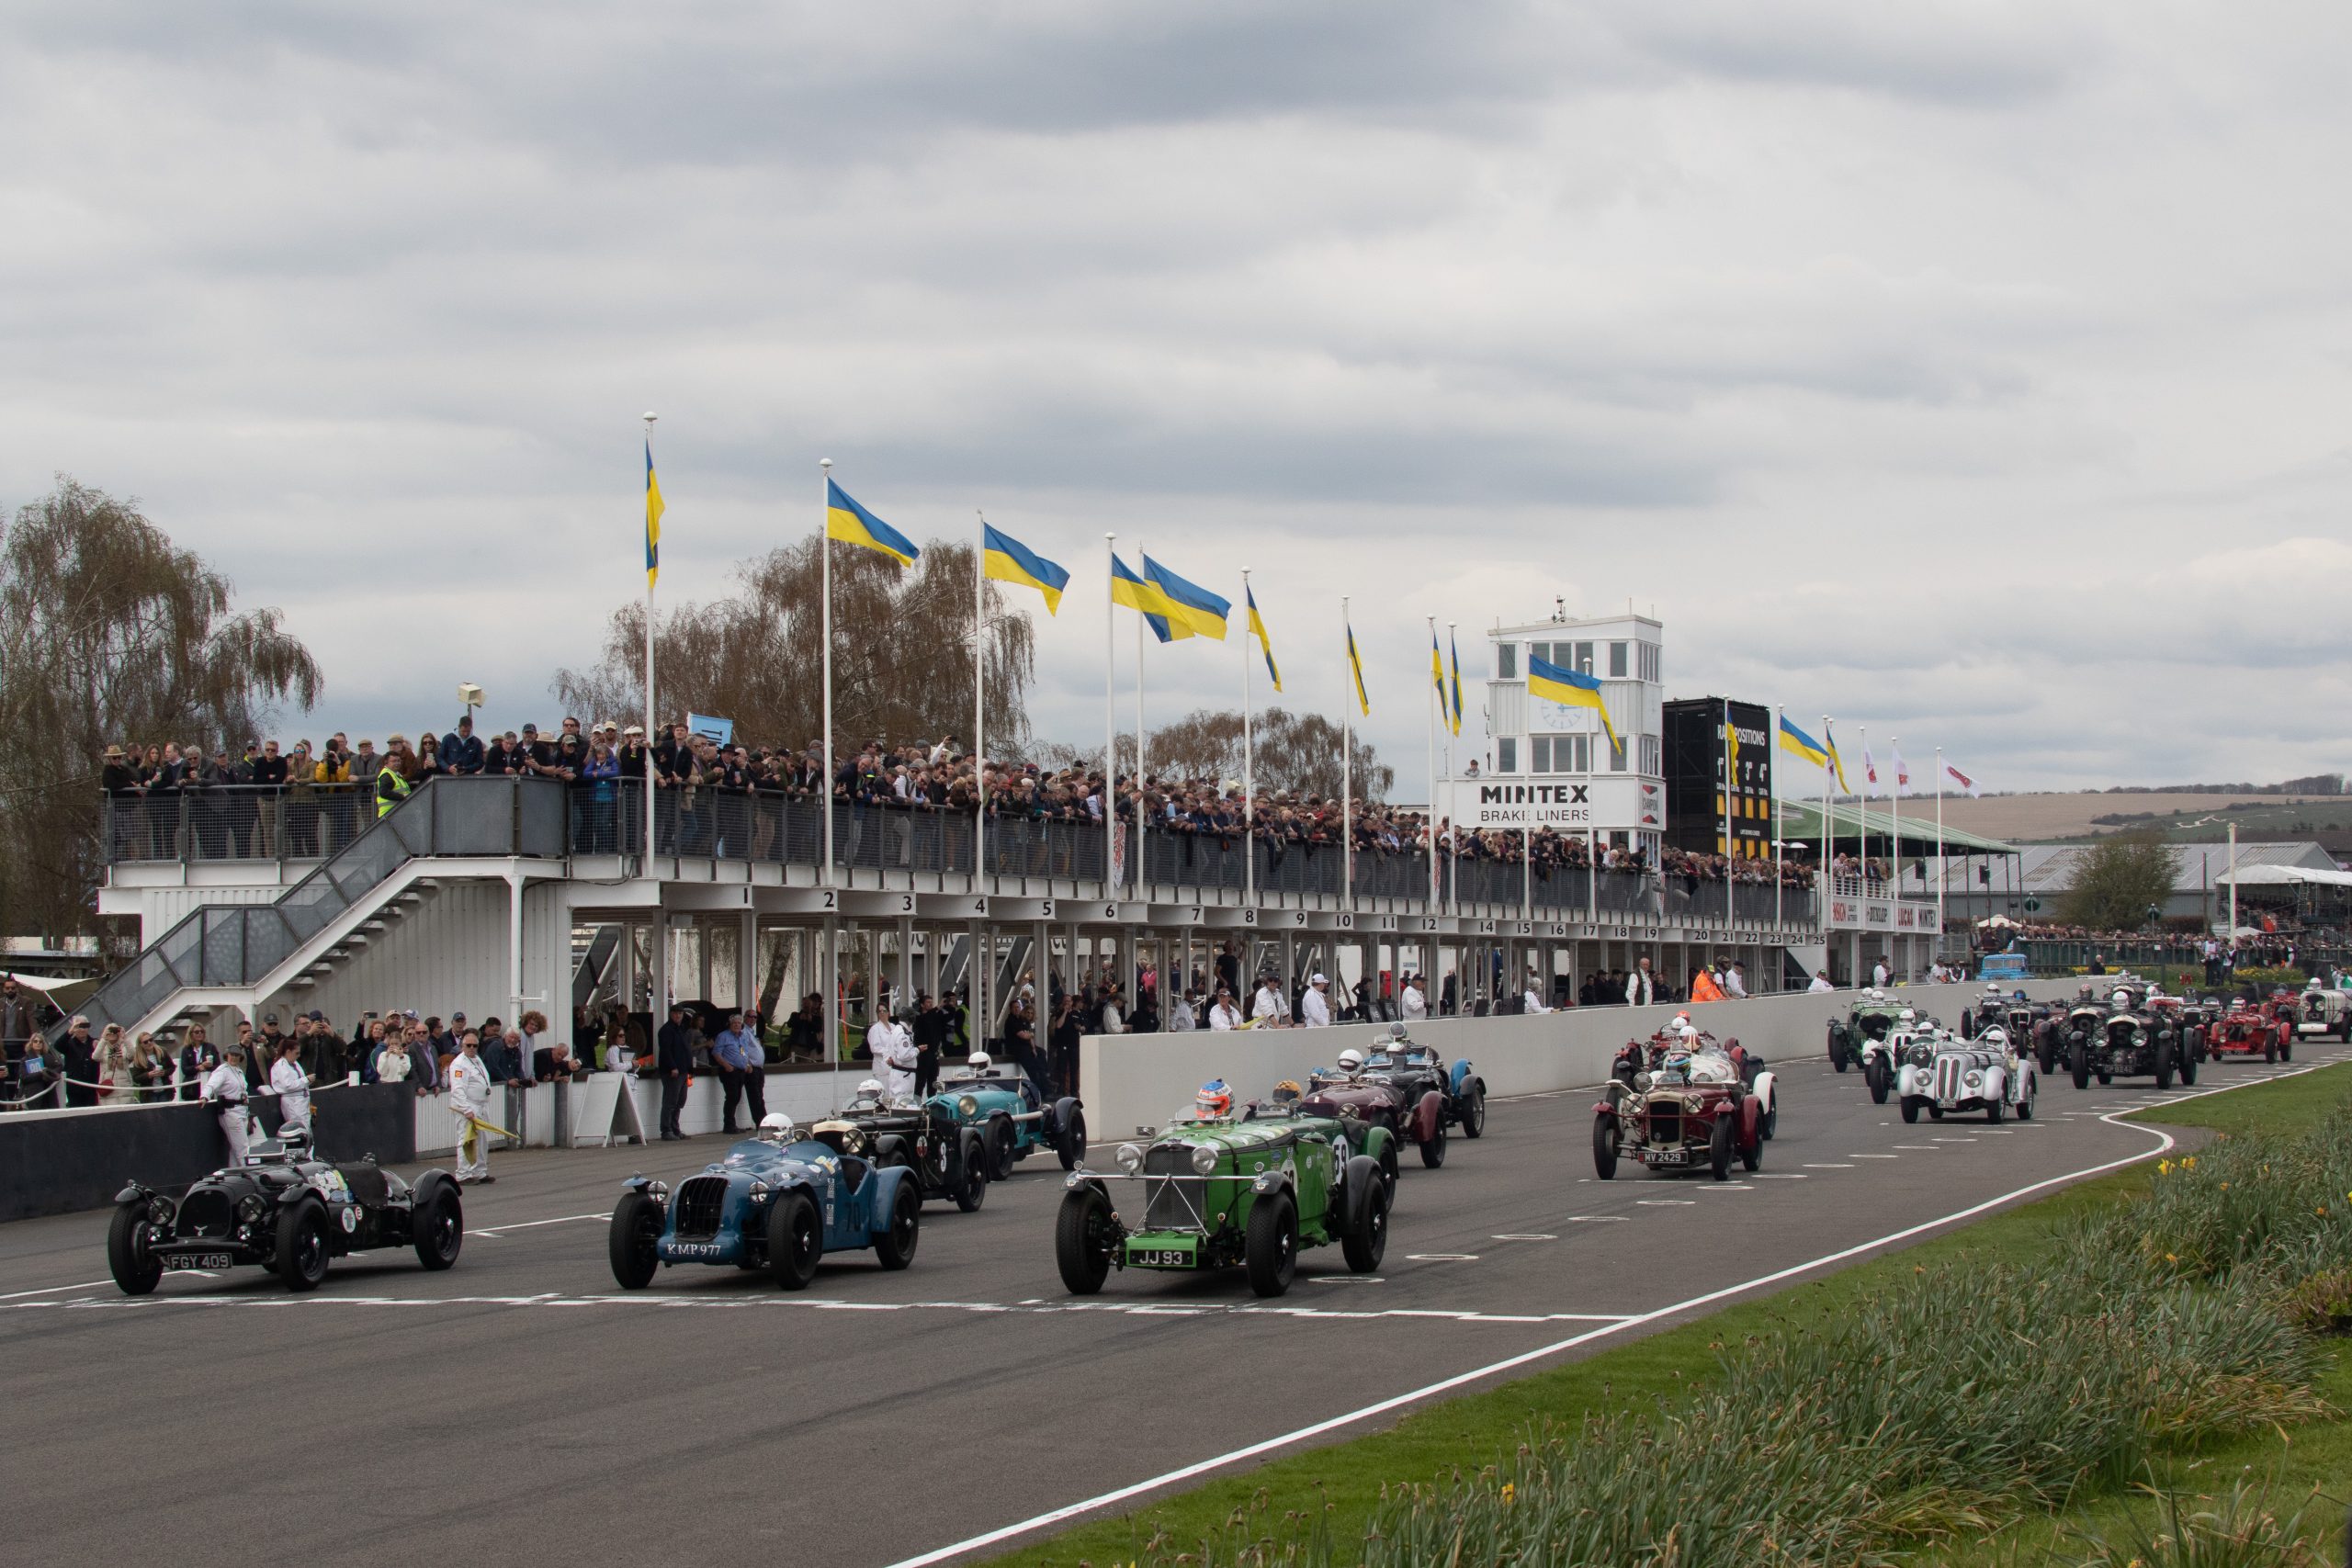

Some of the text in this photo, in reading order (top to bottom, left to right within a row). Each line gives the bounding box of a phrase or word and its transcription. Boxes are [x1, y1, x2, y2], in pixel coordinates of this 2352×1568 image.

[1734, 727, 1766, 746] POSITIONS
[1480, 784, 1589, 804] MINTEX
[1537, 809, 1589, 821] LINERS
[743, 887, 748, 904] 1
[823, 891, 834, 908] 2
[902, 896, 912, 911] 3
[975, 898, 985, 913] 4
[1042, 901, 1052, 916] 5
[1105, 904, 1114, 918] 6
[1192, 908, 1201, 921] 7
[1245, 909, 1254, 923] 8
[1897, 908, 1914, 926] LUCAS
[1296, 912, 1305, 925] 9
[1335, 915, 1351, 927] 10
[1382, 917, 1396, 929] 11
[1918, 908, 1936, 928] MINTEX
[1422, 919, 1436, 931] 12
[1479, 920, 1494, 932] 14
[1517, 923, 1531, 933] 15
[1551, 924, 1564, 935] 16
[1583, 925, 1596, 936] 17
[1614, 927, 1627, 937] 18
[1645, 928, 1657, 938] 19
[1694, 931, 1708, 941] 20
[1723, 931, 1734, 942] 21
[1745, 933, 1758, 942] 22
[1770, 934, 1781, 943] 23
[1792, 935, 1803, 944] 24
[1814, 936, 1825, 945] 25
[2228, 1023, 2244, 1042] 27
[1333, 1144, 1347, 1175] 59
[1645, 1153, 1681, 1162] MV 2429
[667, 1244, 721, 1257] KMP 977
[170, 1254, 230, 1269] FGY 409
[1138, 1251, 1182, 1265] JJ 93
